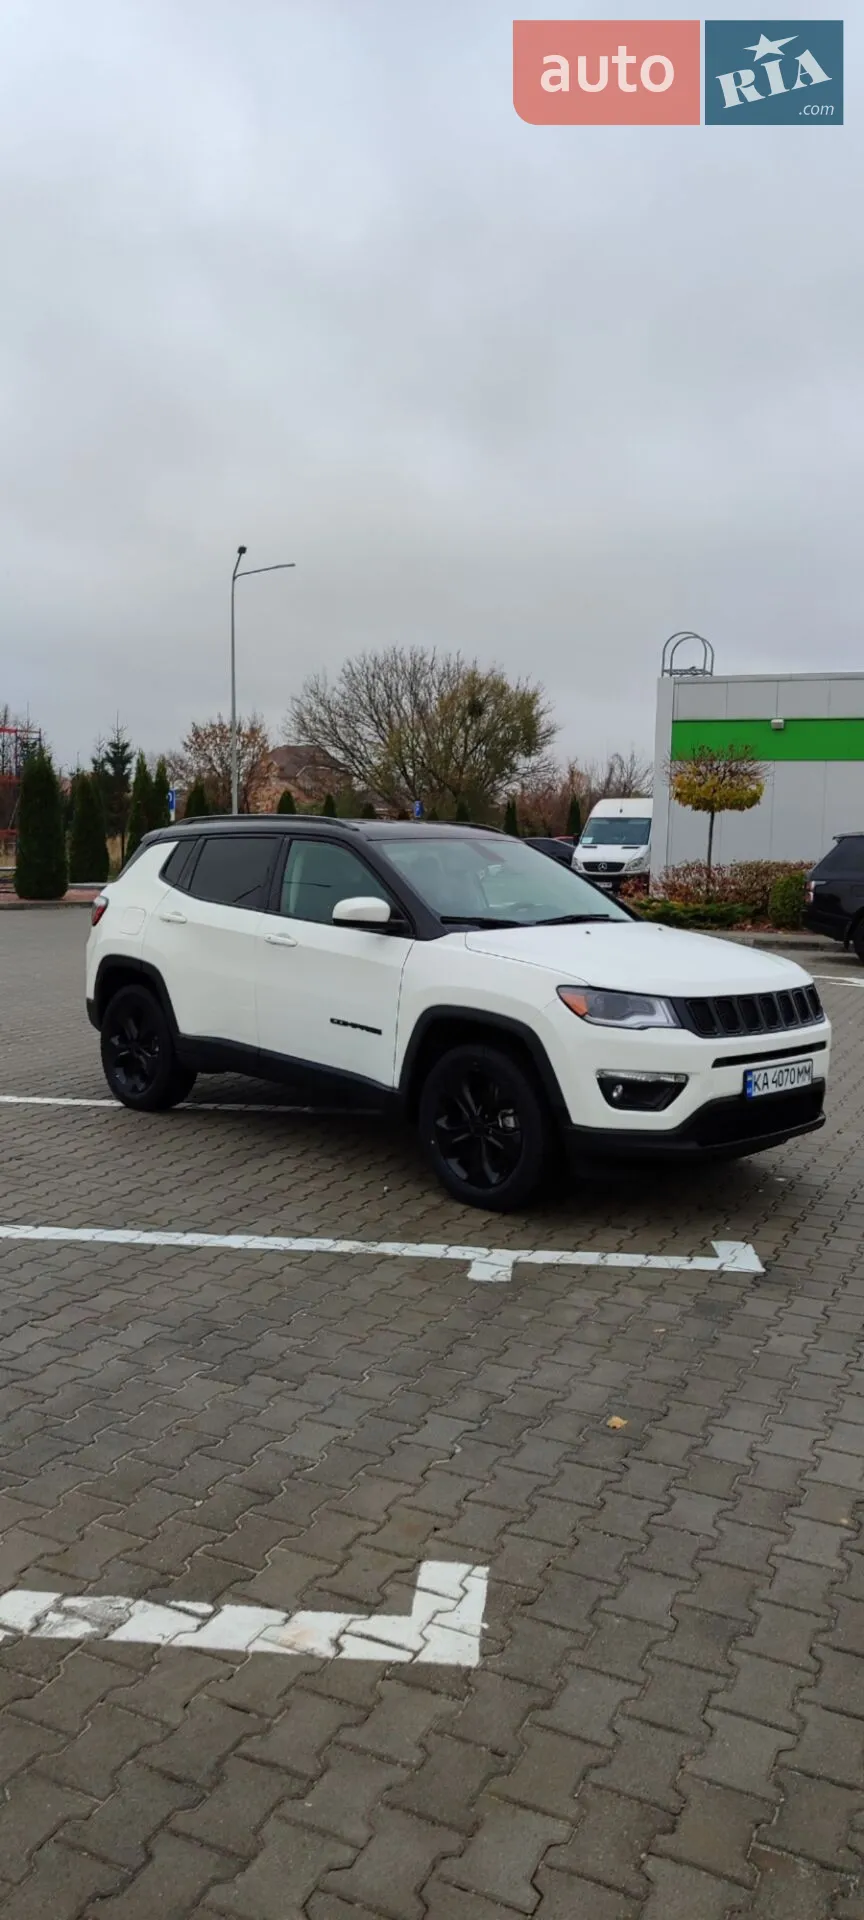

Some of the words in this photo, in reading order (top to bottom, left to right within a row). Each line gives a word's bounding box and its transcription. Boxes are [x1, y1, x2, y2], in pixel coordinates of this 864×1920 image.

[754, 1072, 769, 1092] KA
[771, 1067, 796, 1088] 4070
[797, 1063, 811, 1083] MM
